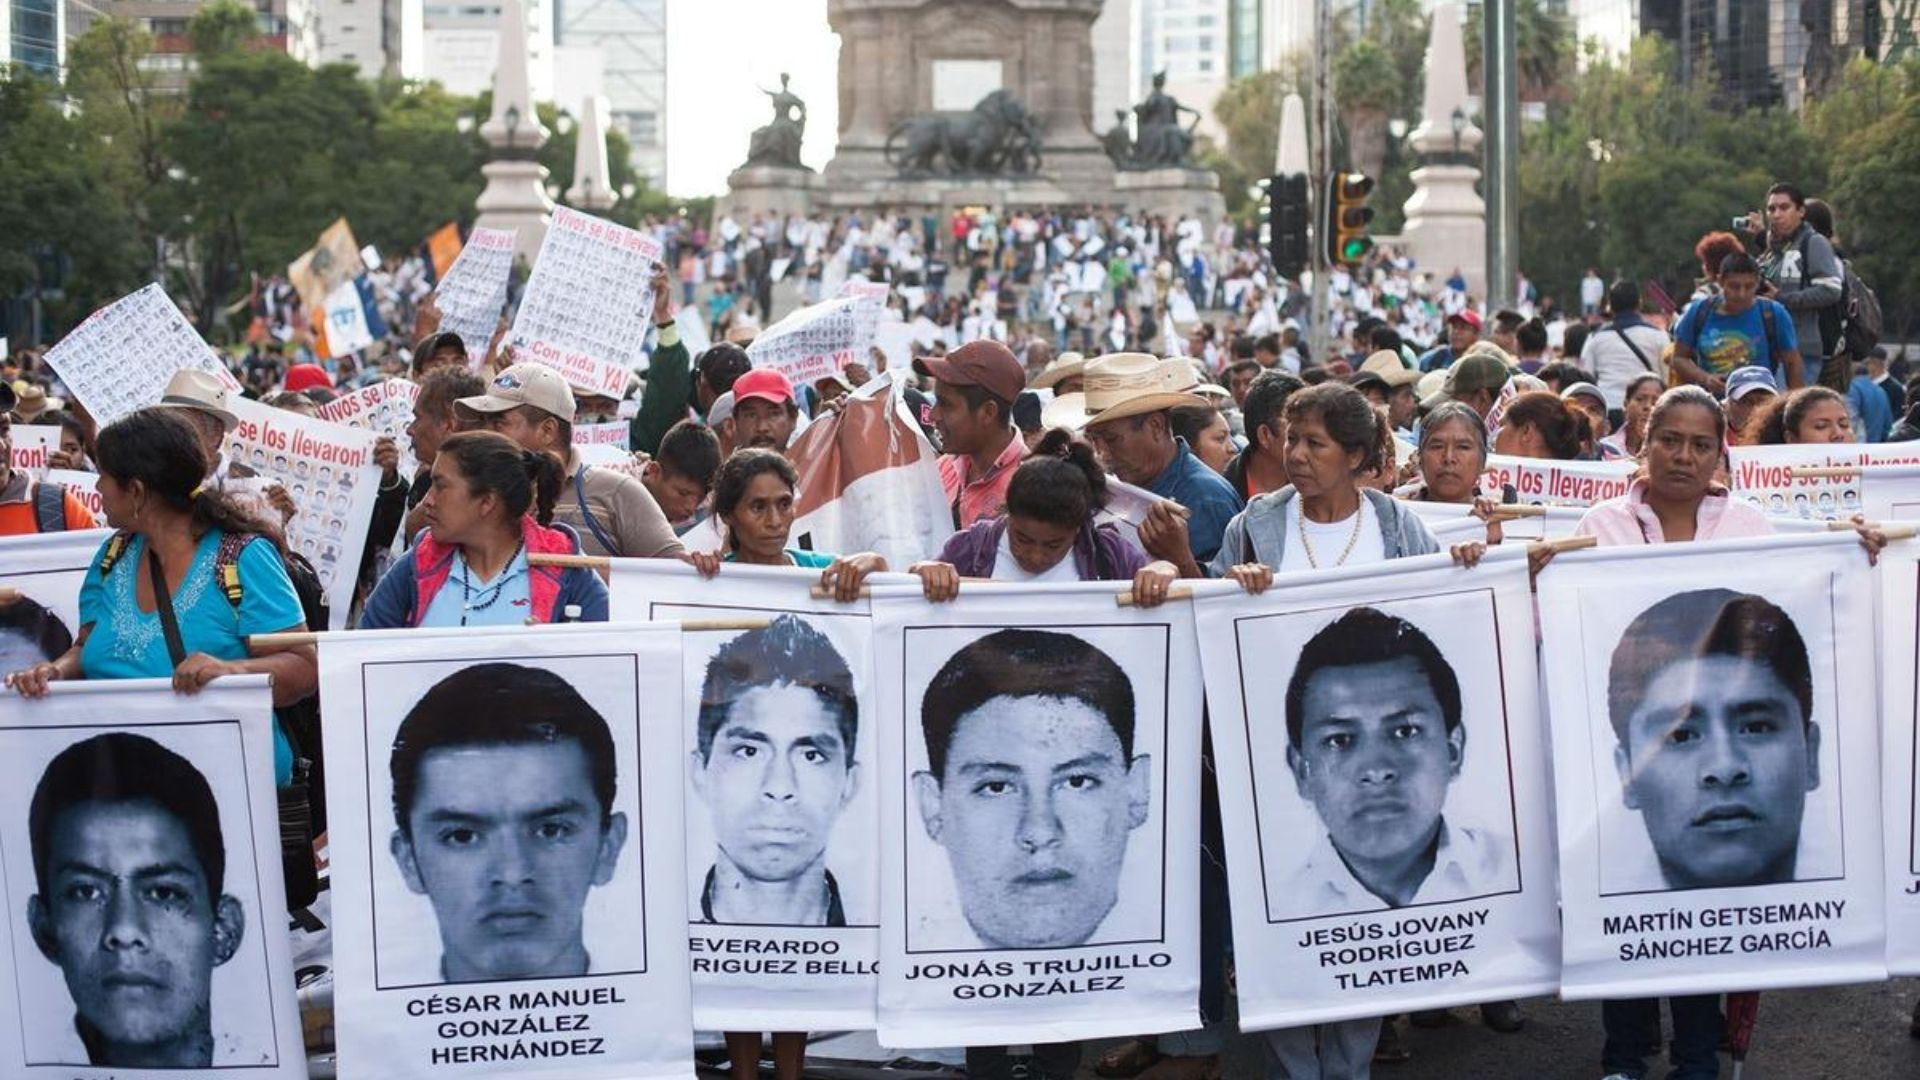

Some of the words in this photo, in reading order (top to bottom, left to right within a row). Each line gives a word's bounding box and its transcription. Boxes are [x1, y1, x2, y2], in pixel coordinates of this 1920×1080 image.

[531, 340, 561, 359] Con
[566, 352, 596, 374] vida
[602, 364, 630, 394] YA!
[795, 355, 824, 369] vida
[362, 387, 382, 407] se
[384, 378, 406, 399] los
[239, 418, 257, 441] se
[262, 421, 287, 450] los
[292, 428, 367, 468] llevaron!
[1488, 467, 1511, 490] se
[1516, 464, 1543, 494] los
[1550, 467, 1633, 504] llevaron!
[1735, 459, 1793, 490] ¡Vivos
[1298, 922, 1384, 947] JESÚS
[1388, 909, 1490, 938] JOVANY
[1602, 908, 1693, 936] MARTÍN
[1699, 899, 1846, 928] GETSEMANY
[688, 937, 841, 955] EVERARDO
[1319, 934, 1476, 967] RODRÍGUEZ
[1619, 936, 1734, 961] SÁNCHEZ
[1740, 926, 1832, 953] GARCÍA
[905, 959, 1015, 980] JONÁS
[1022, 953, 1173, 976] TRUJILLO
[1334, 960, 1470, 990] TLATEMPA
[406, 994, 502, 1016] CÉSAR
[509, 987, 626, 1010] MANUEL
[952, 975, 1126, 1000] GONZÁLEZ
[437, 1013, 591, 1039] GONZÁLEZ
[431, 1038, 606, 1065] HERNÁNDEZ
